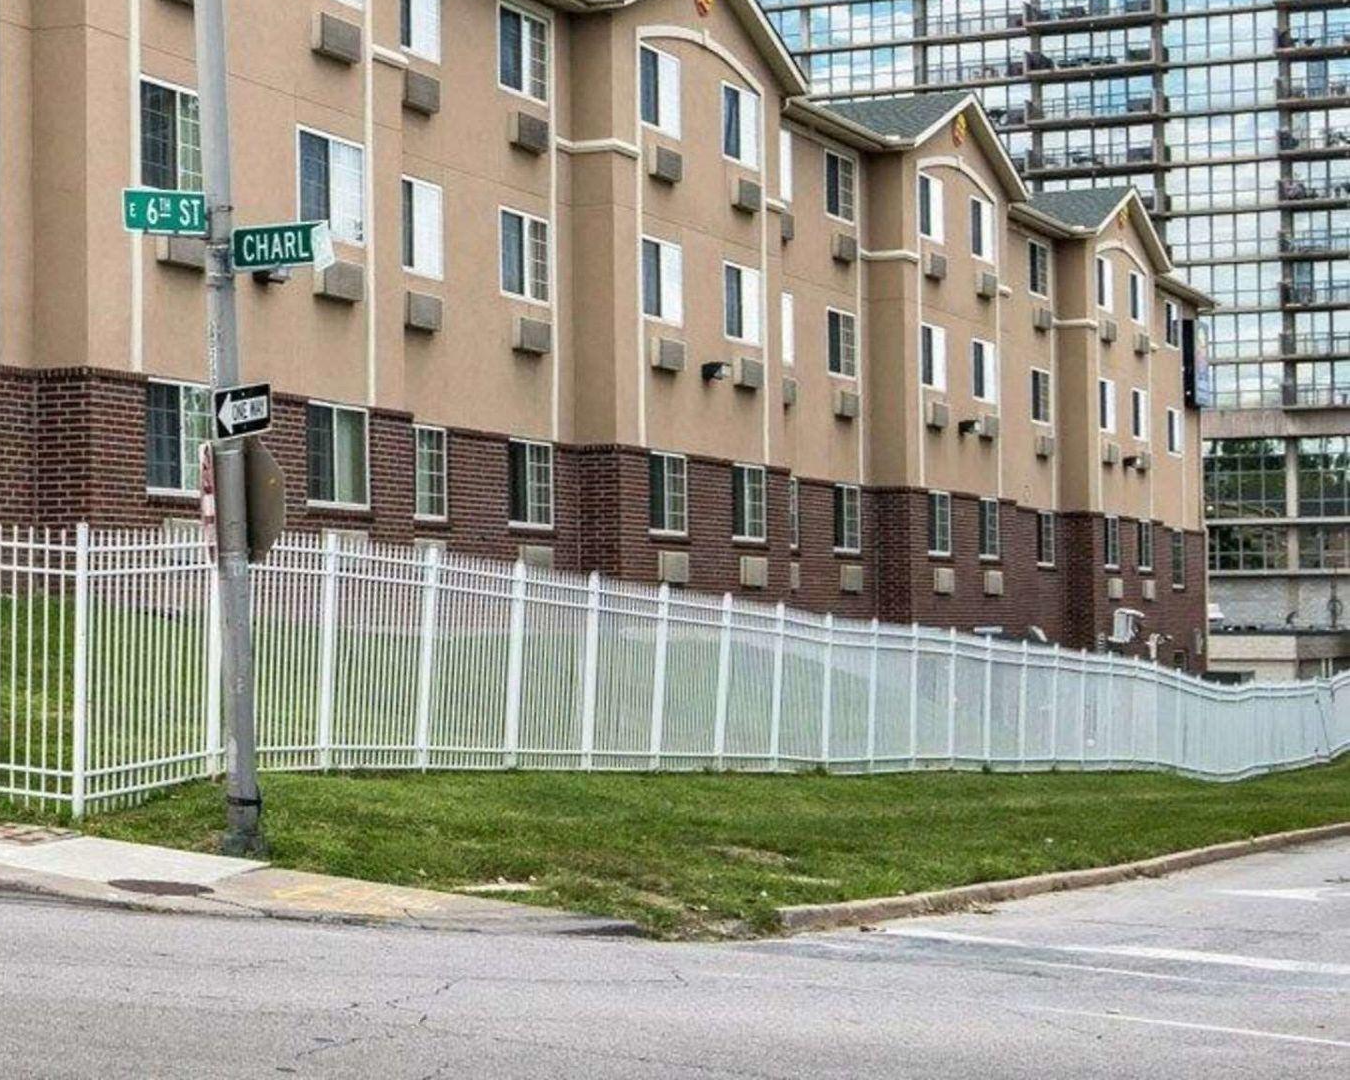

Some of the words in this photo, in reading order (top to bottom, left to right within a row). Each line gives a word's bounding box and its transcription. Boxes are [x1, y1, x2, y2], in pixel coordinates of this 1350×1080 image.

[129, 202, 137, 218] E
[146, 197, 172, 225] 6TH
[179, 199, 201, 226] ST
[242, 231, 310, 261] CHARL
[232, 401, 249, 421] ONE
[250, 398, 265, 418] WAY
